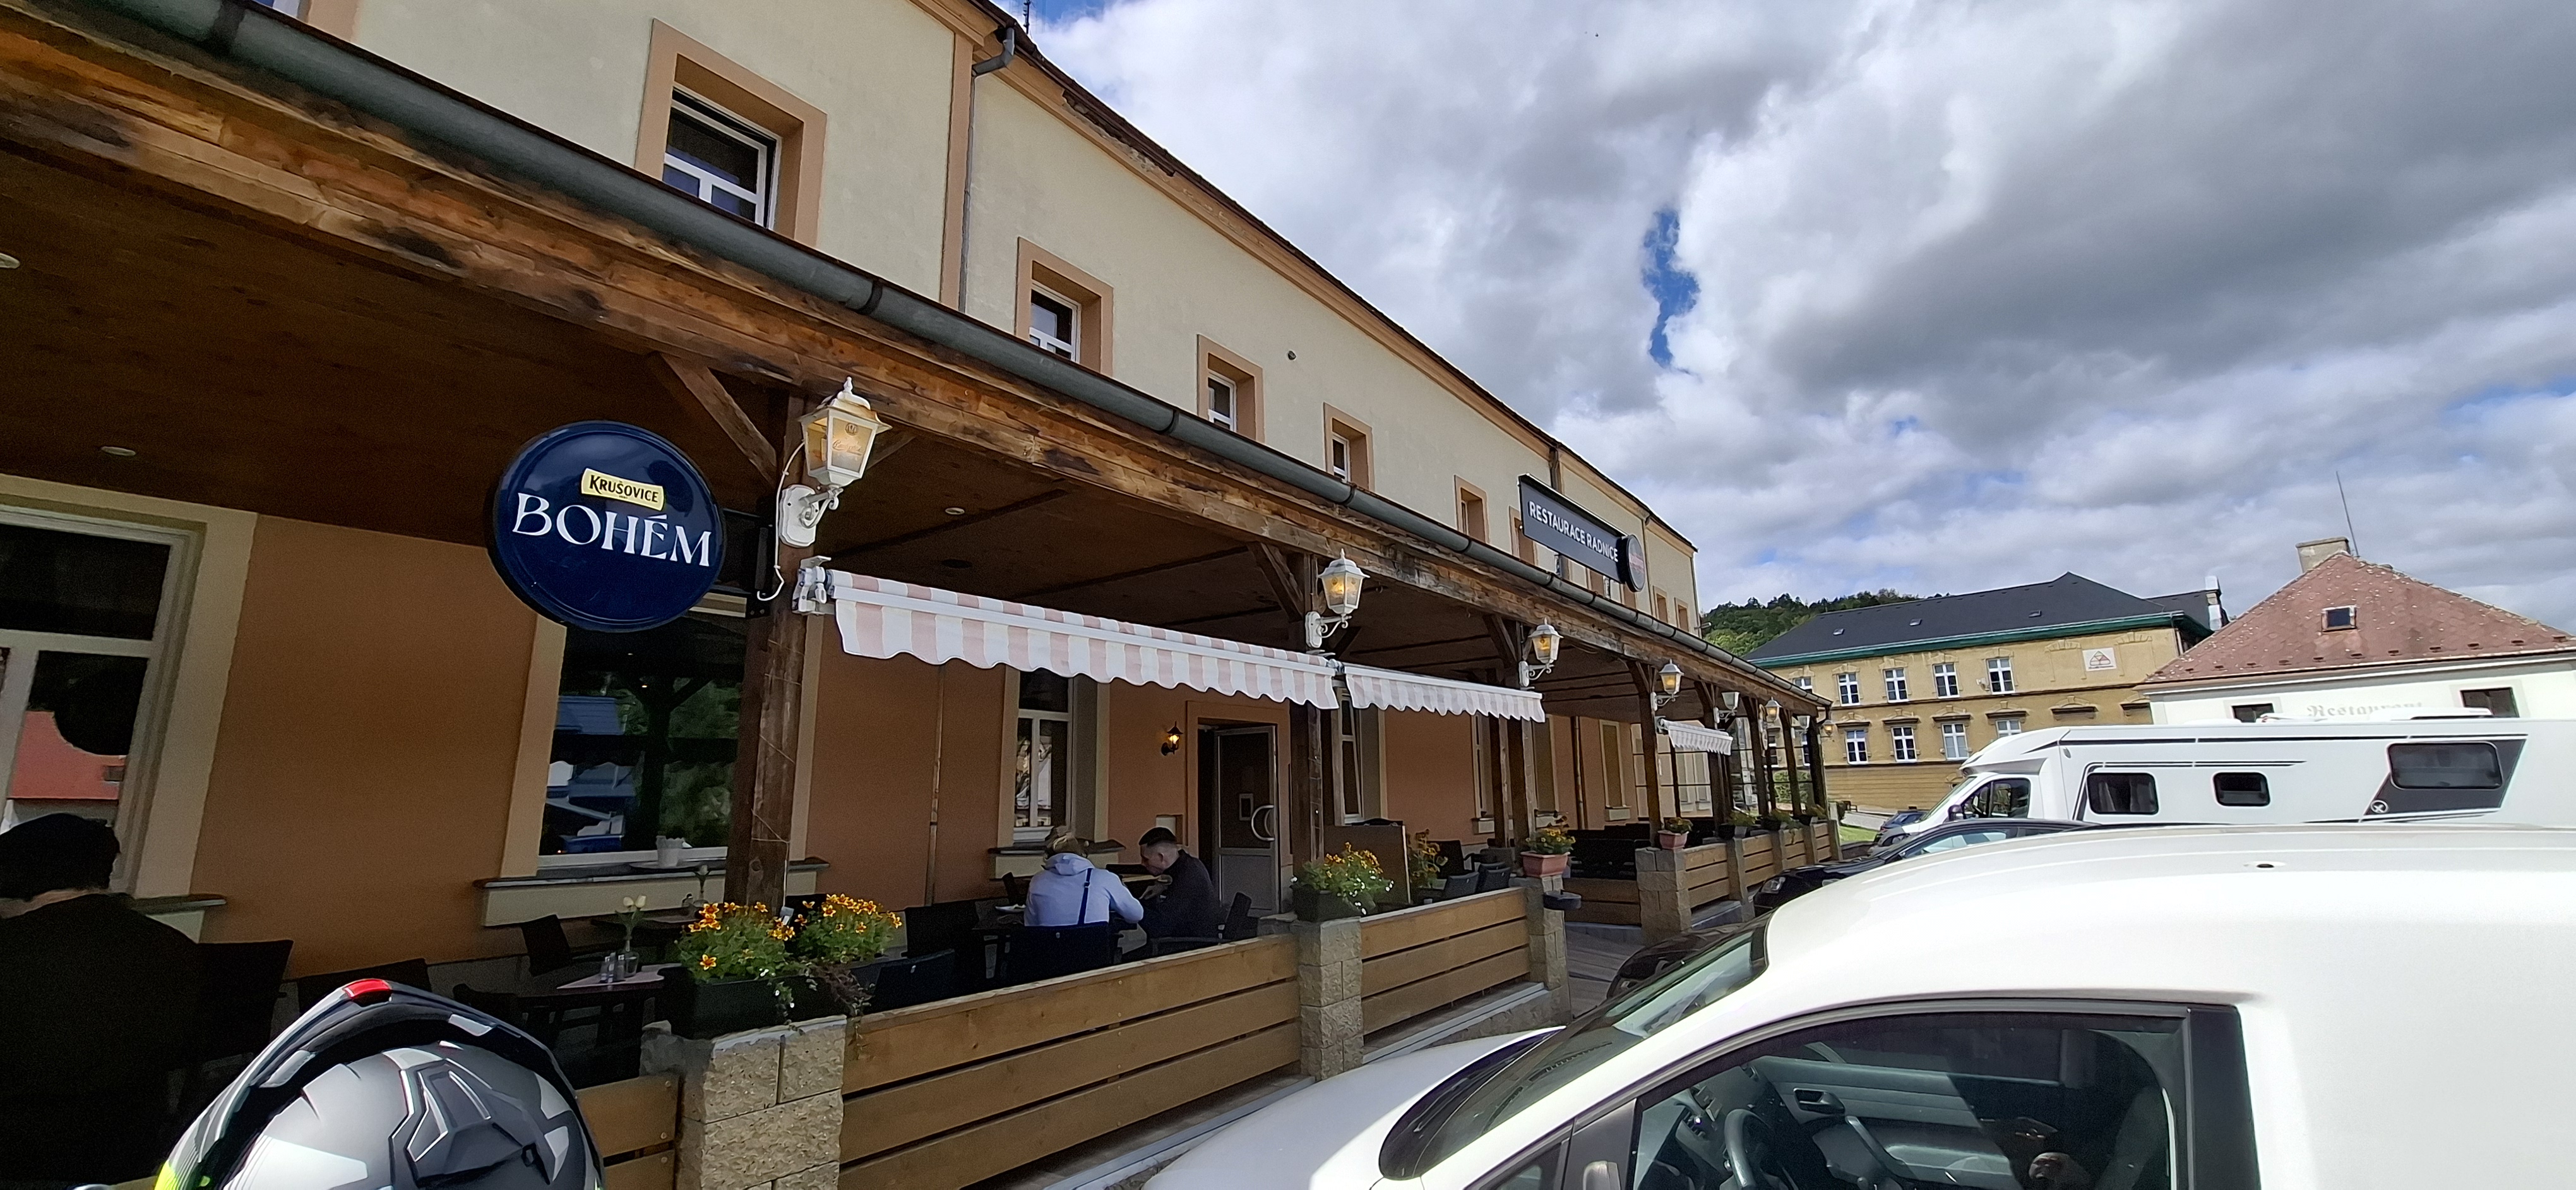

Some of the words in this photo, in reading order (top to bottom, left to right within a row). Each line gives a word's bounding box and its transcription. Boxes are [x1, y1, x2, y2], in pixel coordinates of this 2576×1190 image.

[589, 474, 659, 503] KRUŠOVICE
[512, 492, 712, 567] BOHÉM
[1529, 500, 1586, 544] RESTAURACE
[1586, 532, 1618, 562] RADNICE
